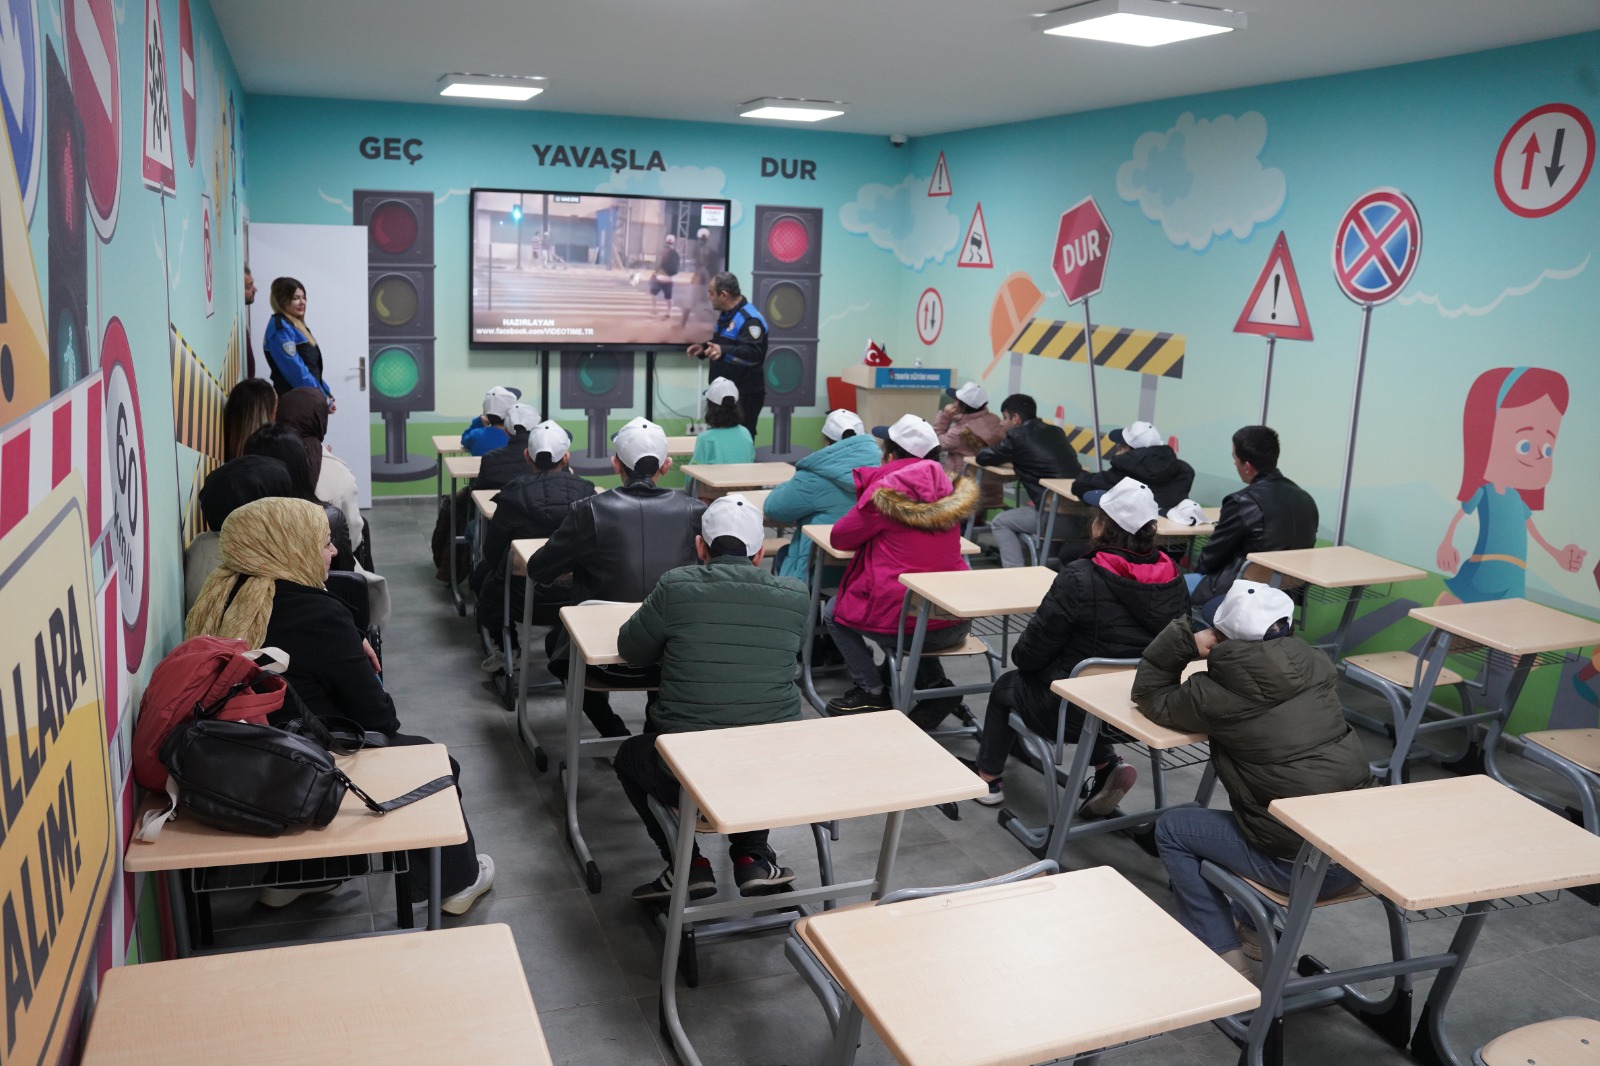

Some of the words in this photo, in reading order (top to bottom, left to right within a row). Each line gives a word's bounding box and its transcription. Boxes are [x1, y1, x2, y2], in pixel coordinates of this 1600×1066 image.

[359, 136, 424, 166] GEÇ
[532, 144, 666, 174] YAVAŞLA
[761, 156, 817, 181] DUR
[1062, 229, 1102, 275] DUR
[502, 318, 555, 327] HAZIRLAYAN
[116, 401, 138, 537] 60
[114, 491, 134, 595] km/h
[0, 584, 87, 846] LLARA
[2, 759, 82, 1059] ALIM!
